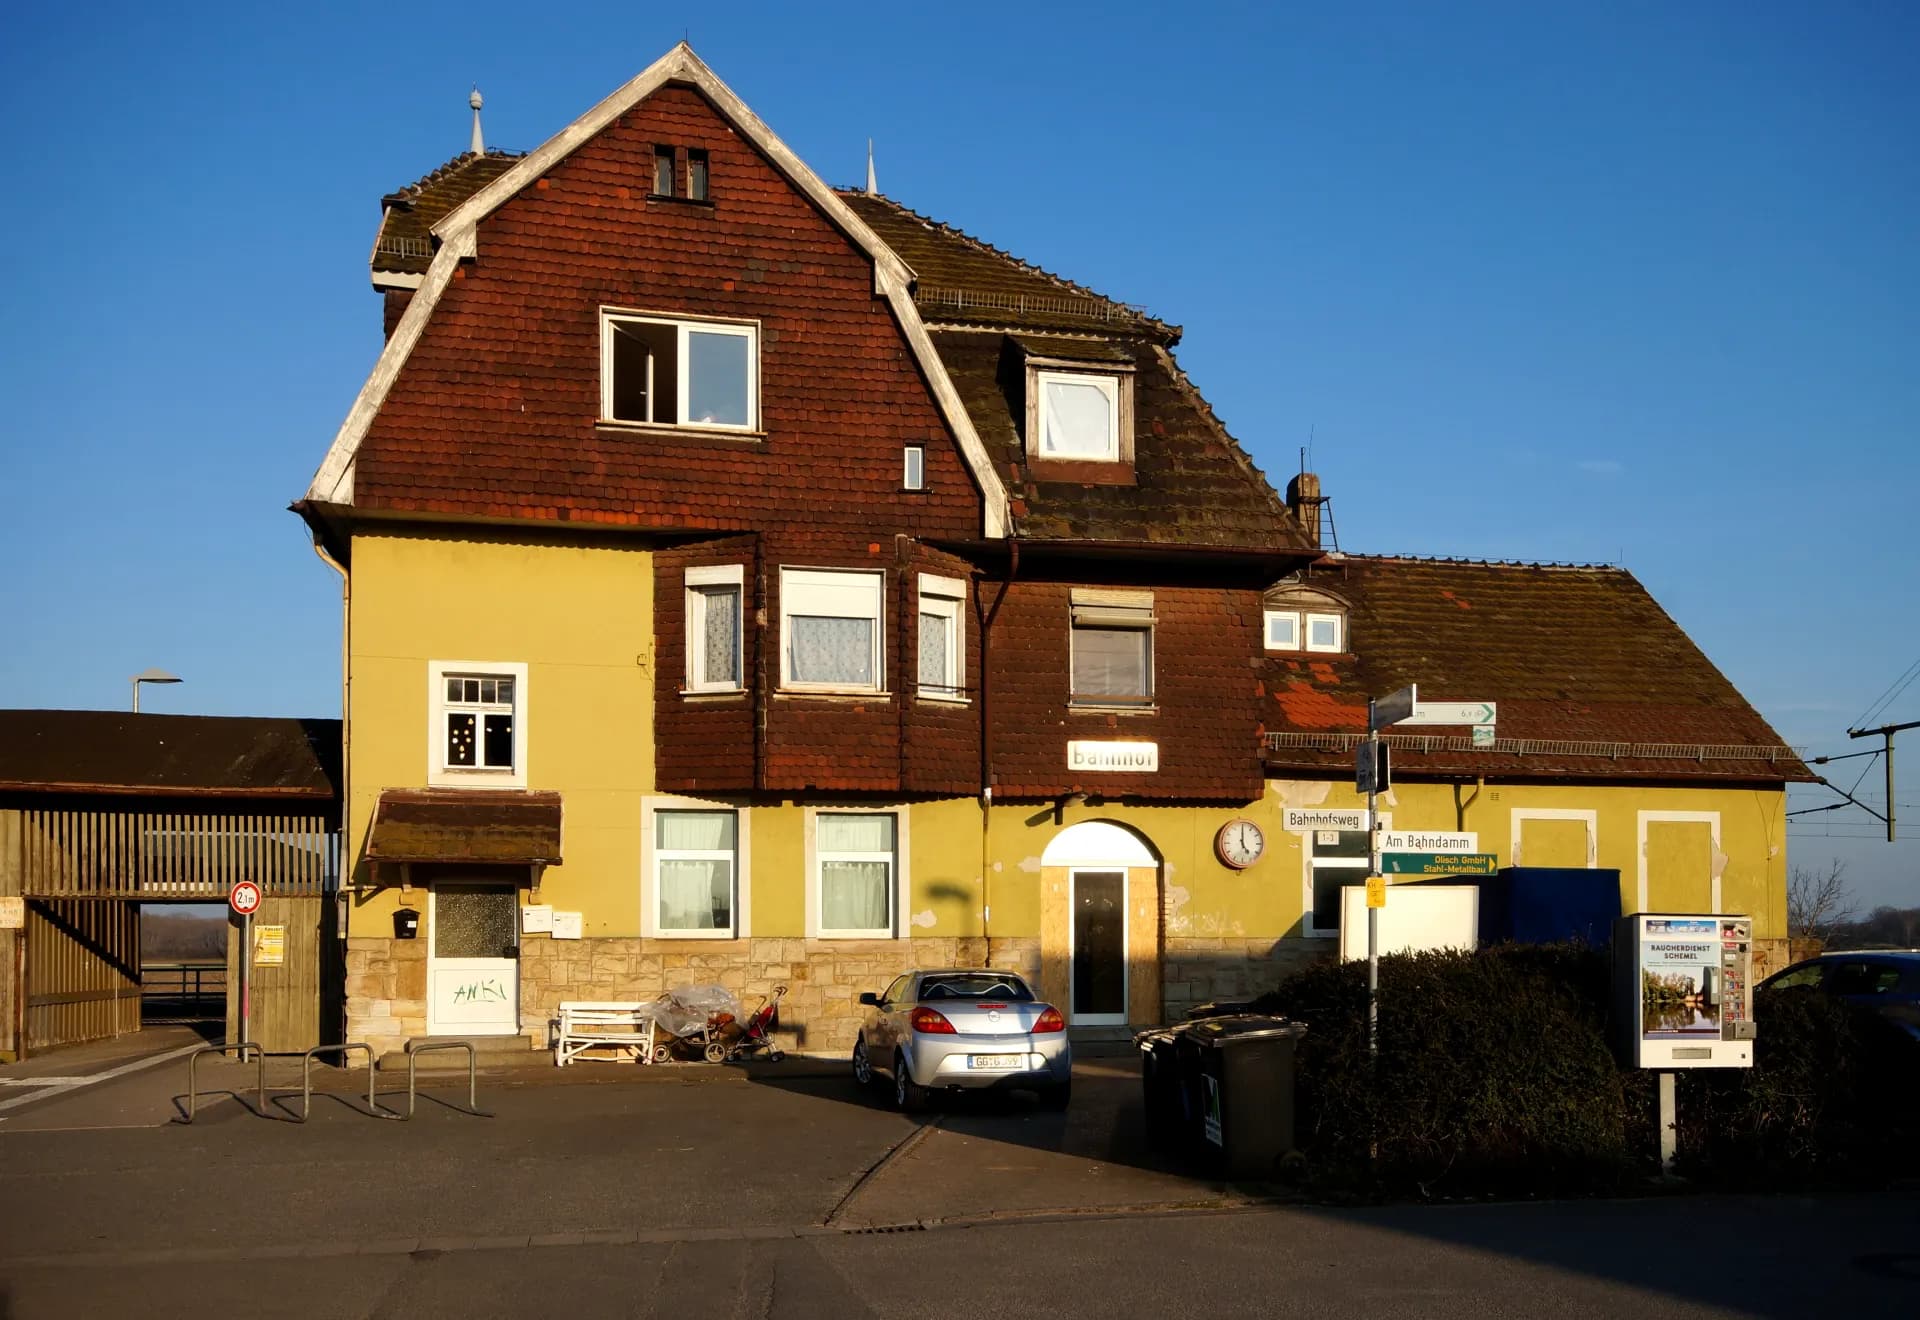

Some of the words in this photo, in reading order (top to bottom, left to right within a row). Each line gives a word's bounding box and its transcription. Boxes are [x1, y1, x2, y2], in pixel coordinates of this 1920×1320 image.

[1290, 812, 1360, 829] Bahnhofsweg
[1386, 834, 1403, 848] Am
[1408, 834, 1470, 849] Bahndamm
[1461, 855, 1486, 865] GmbH
[1423, 864, 1486, 874] Stahl-Metallbau
[1650, 944, 1711, 952] RAUCHERDIENST
[1664, 952, 1698, 960] SCHEMEL
